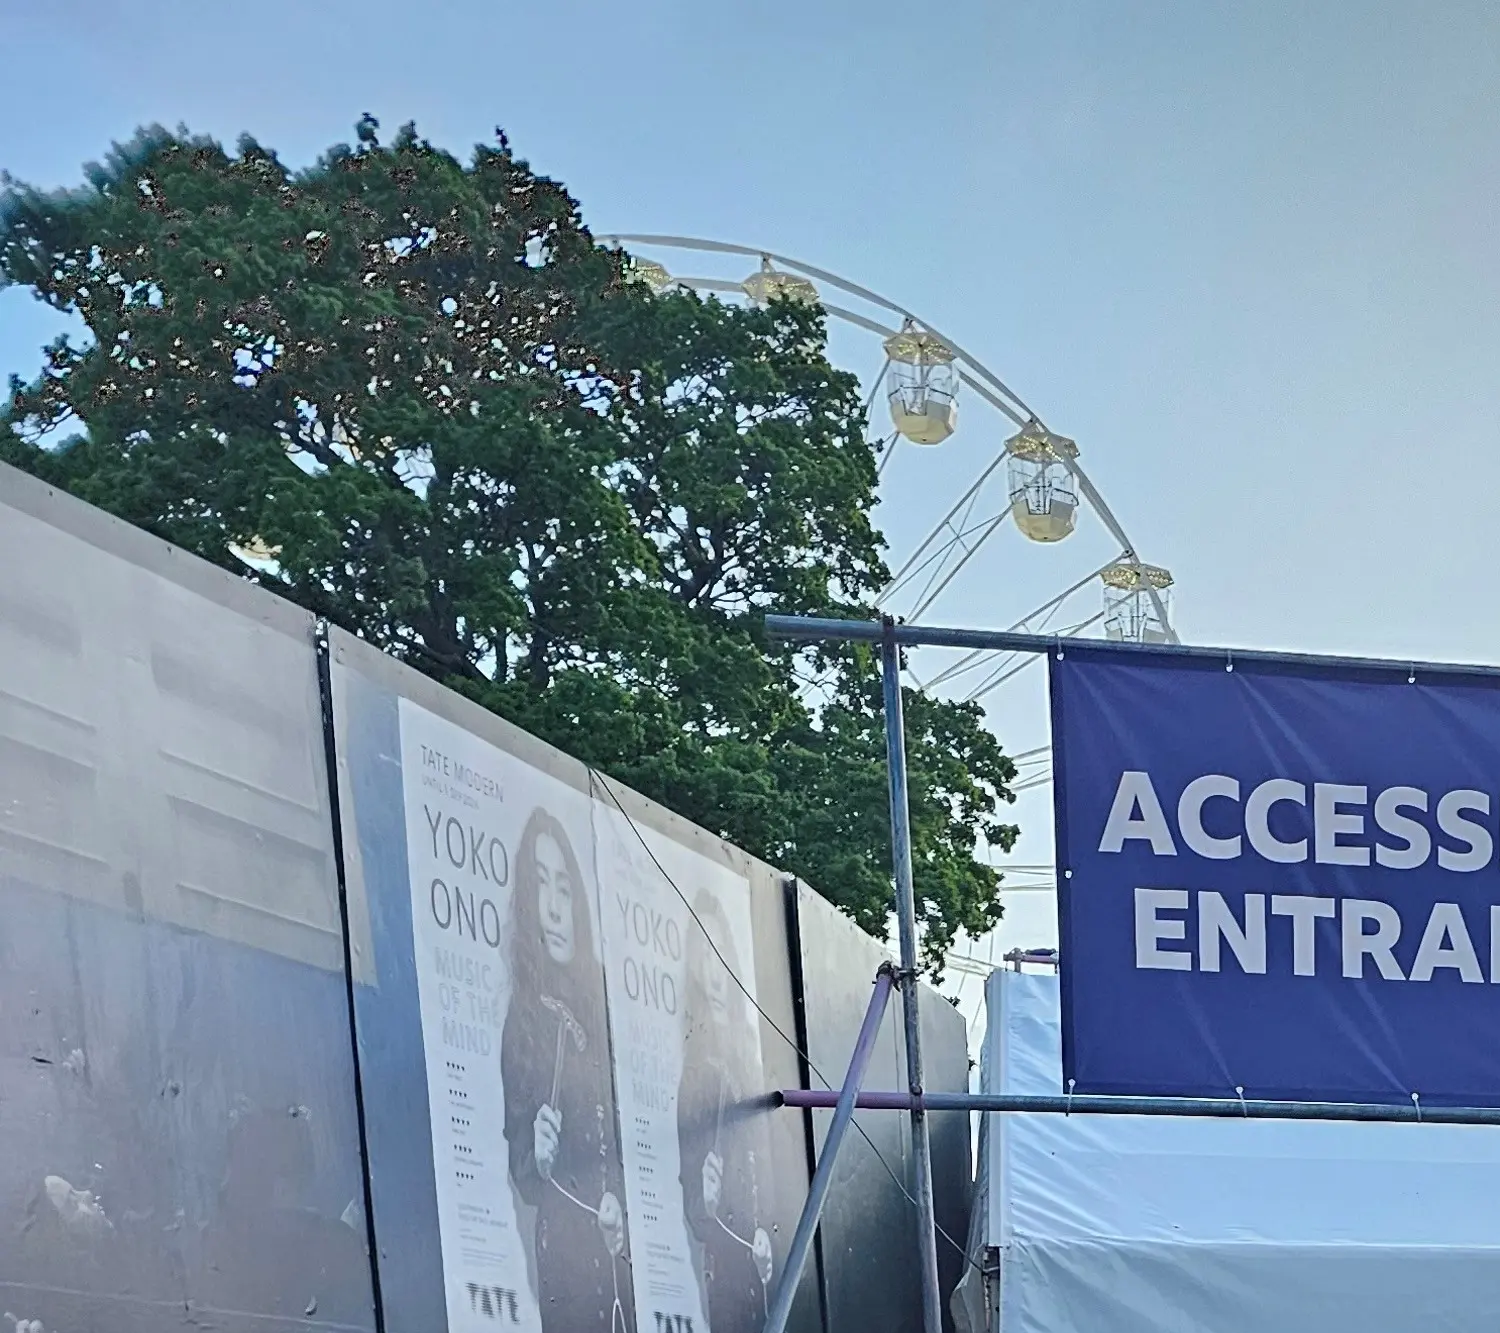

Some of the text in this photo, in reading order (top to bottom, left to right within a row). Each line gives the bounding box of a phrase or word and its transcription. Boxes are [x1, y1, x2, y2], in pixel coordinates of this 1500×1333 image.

[421, 744, 450, 778] TATE
[453, 761, 504, 803] MODERN
[424, 804, 509, 888] YOKO
[431, 878, 500, 948] ONO
[616, 892, 681, 962] YOKO
[434, 946, 493, 992] MUSIC
[623, 956, 677, 1016] ONO
[439, 982, 502, 1029] OF THE
[441, 1015, 492, 1056] MIND
[465, 1281, 520, 1325] TATE
